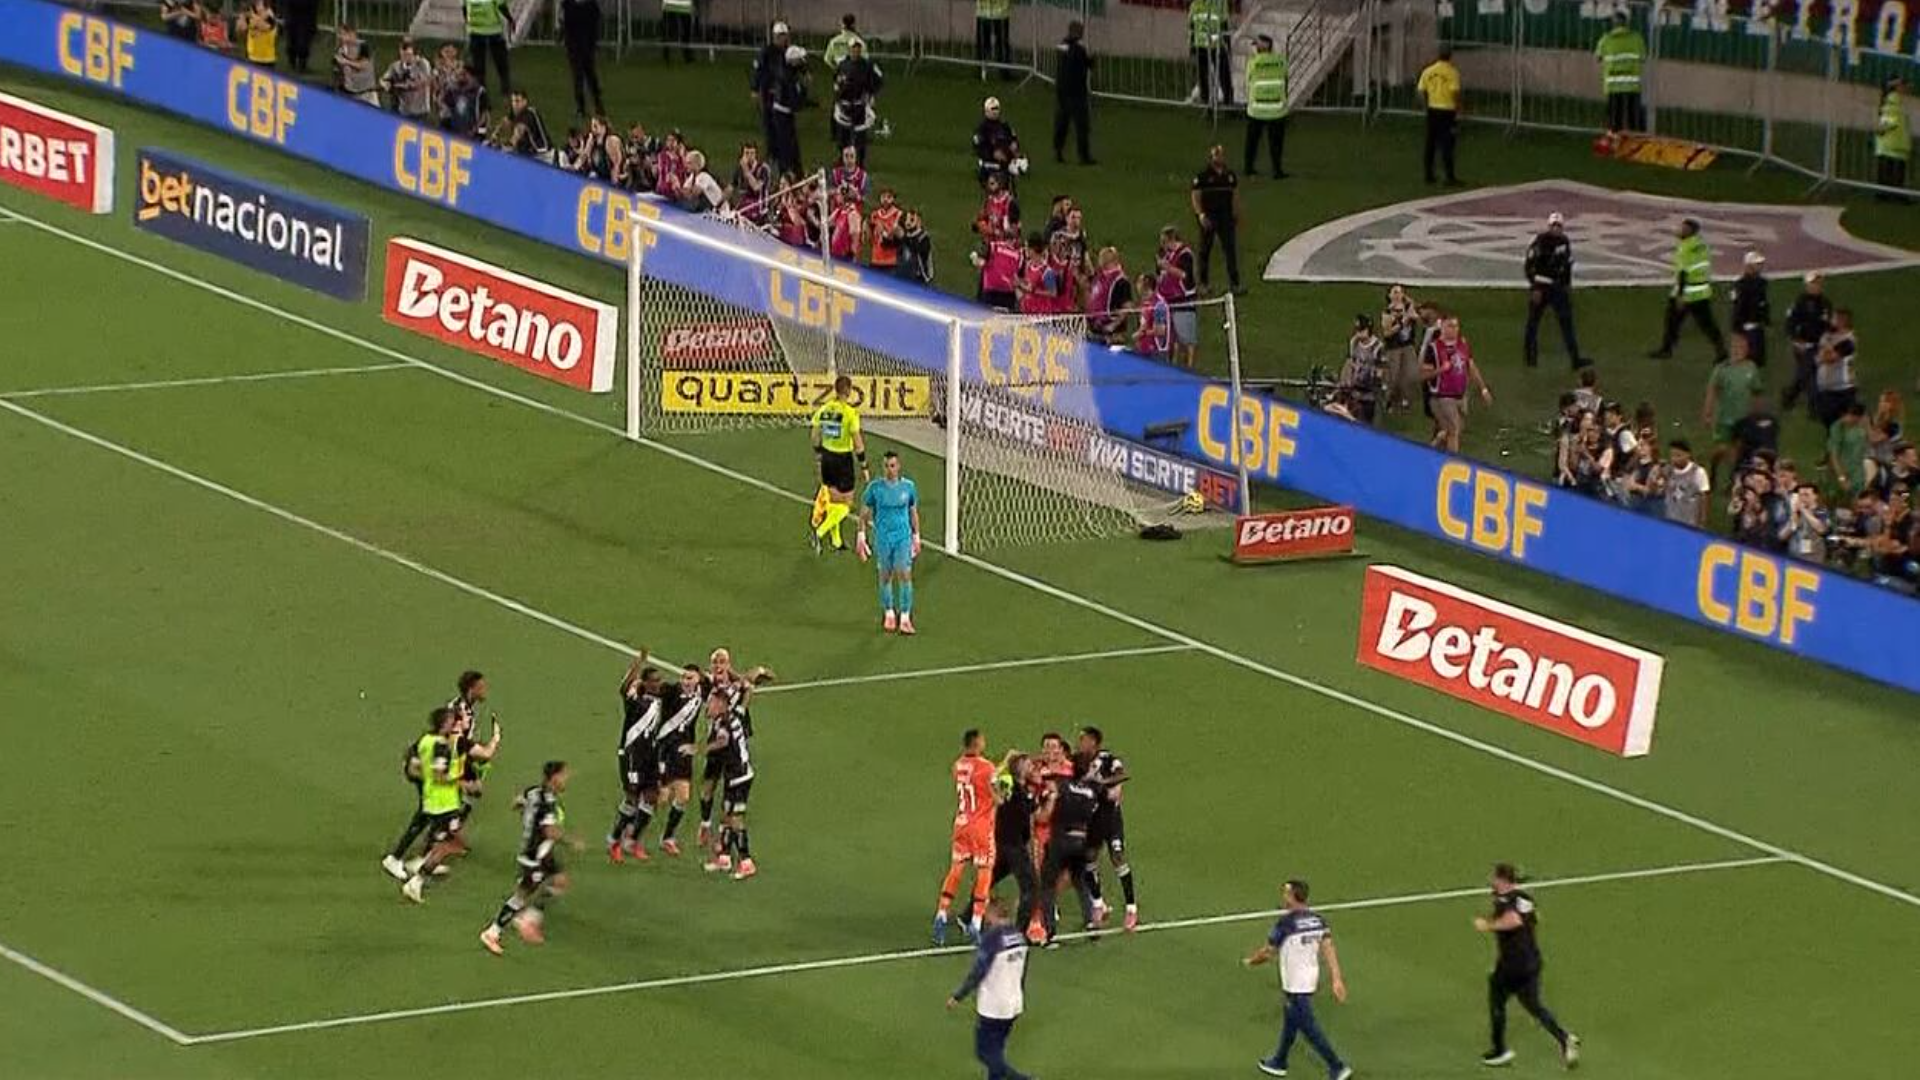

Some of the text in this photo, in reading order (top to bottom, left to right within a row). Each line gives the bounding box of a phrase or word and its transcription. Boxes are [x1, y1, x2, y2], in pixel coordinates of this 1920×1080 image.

[58, 11, 136, 88] CBF
[227, 65, 298, 143] CBF
[394, 123, 473, 206] CBF
[397, 258, 583, 371] Betano
[769, 249, 860, 333] CBF
[1197, 384, 1300, 480] CBF
[1131, 450, 1196, 494] SORTE
[1199, 470, 1237, 507] BET
[1436, 460, 1548, 559] CBF
[1240, 515, 1351, 546] Betano
[1697, 538, 1821, 645] CBF
[1377, 590, 1617, 729] Betano
